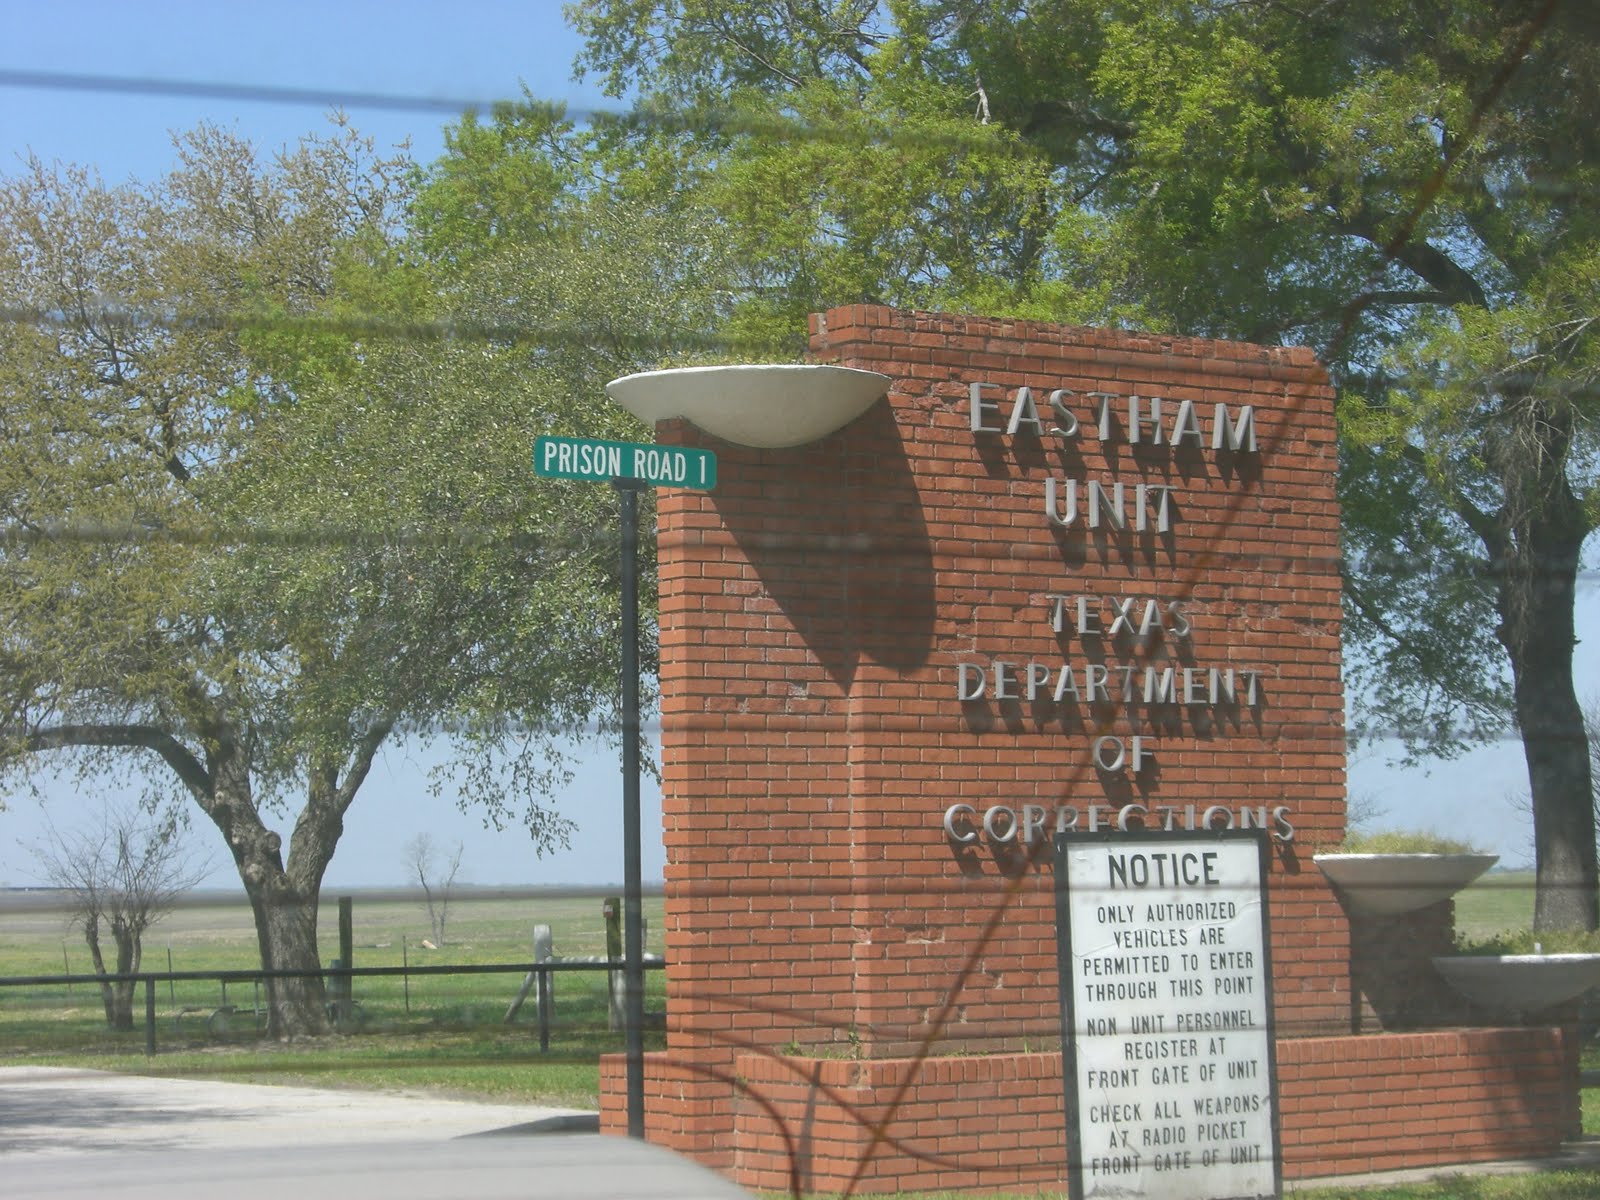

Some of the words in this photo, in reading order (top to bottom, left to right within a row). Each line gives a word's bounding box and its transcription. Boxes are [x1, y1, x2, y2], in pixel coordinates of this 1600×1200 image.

[969, 382, 1257, 452] EASTHAM
[544, 442, 621, 476] PRISON
[634, 449, 686, 482] ROAD
[699, 456, 705, 484] 1
[1045, 477, 1178, 533] UNIT
[1045, 594, 1191, 636] TEXAS
[957, 662, 1262, 705] DEPARTMENT
[1094, 736, 1154, 772] OF
[944, 803, 1295, 842] CORRECTIONS
[1109, 853, 1220, 889] NOTICE
[1098, 905, 1134, 924] ONLY
[1147, 902, 1236, 922] AUTHORIZED
[1114, 929, 1188, 949] VEHICLES
[1200, 928, 1225, 945] ARE
[1084, 956, 1169, 976] PERMITTED
[1181, 954, 1198, 971] TO
[1211, 952, 1253, 970] ENTER
[1086, 982, 1157, 1002] THROUGH
[1170, 979, 1202, 997] THIS
[1215, 977, 1253, 995] POINT
[1088, 1017, 1116, 1036] NON
[1132, 1015, 1164, 1034] UNIT
[1177, 1010, 1255, 1032] PERSONNEL
[1125, 1040, 1197, 1060] REGISTER
[1209, 1038, 1225, 1055] AT
[1088, 1069, 1139, 1089] FRONT
[1152, 1066, 1189, 1085] GATE
[1200, 1064, 1216, 1081] OF
[1228, 1060, 1257, 1079] UNIT
[1091, 1104, 1142, 1123] CHECK
[1154, 1101, 1181, 1120] ALL
[1194, 1095, 1259, 1116] WEAPONS
[1110, 1131, 1128, 1149] AT
[1144, 1127, 1185, 1146] RADIO
[1198, 1121, 1246, 1141] PICKET
[1093, 1156, 1141, 1176] FRONT
[1155, 1151, 1191, 1171] GATE
[1203, 1149, 1219, 1167] OF
[1231, 1145, 1260, 1164] UNIT
